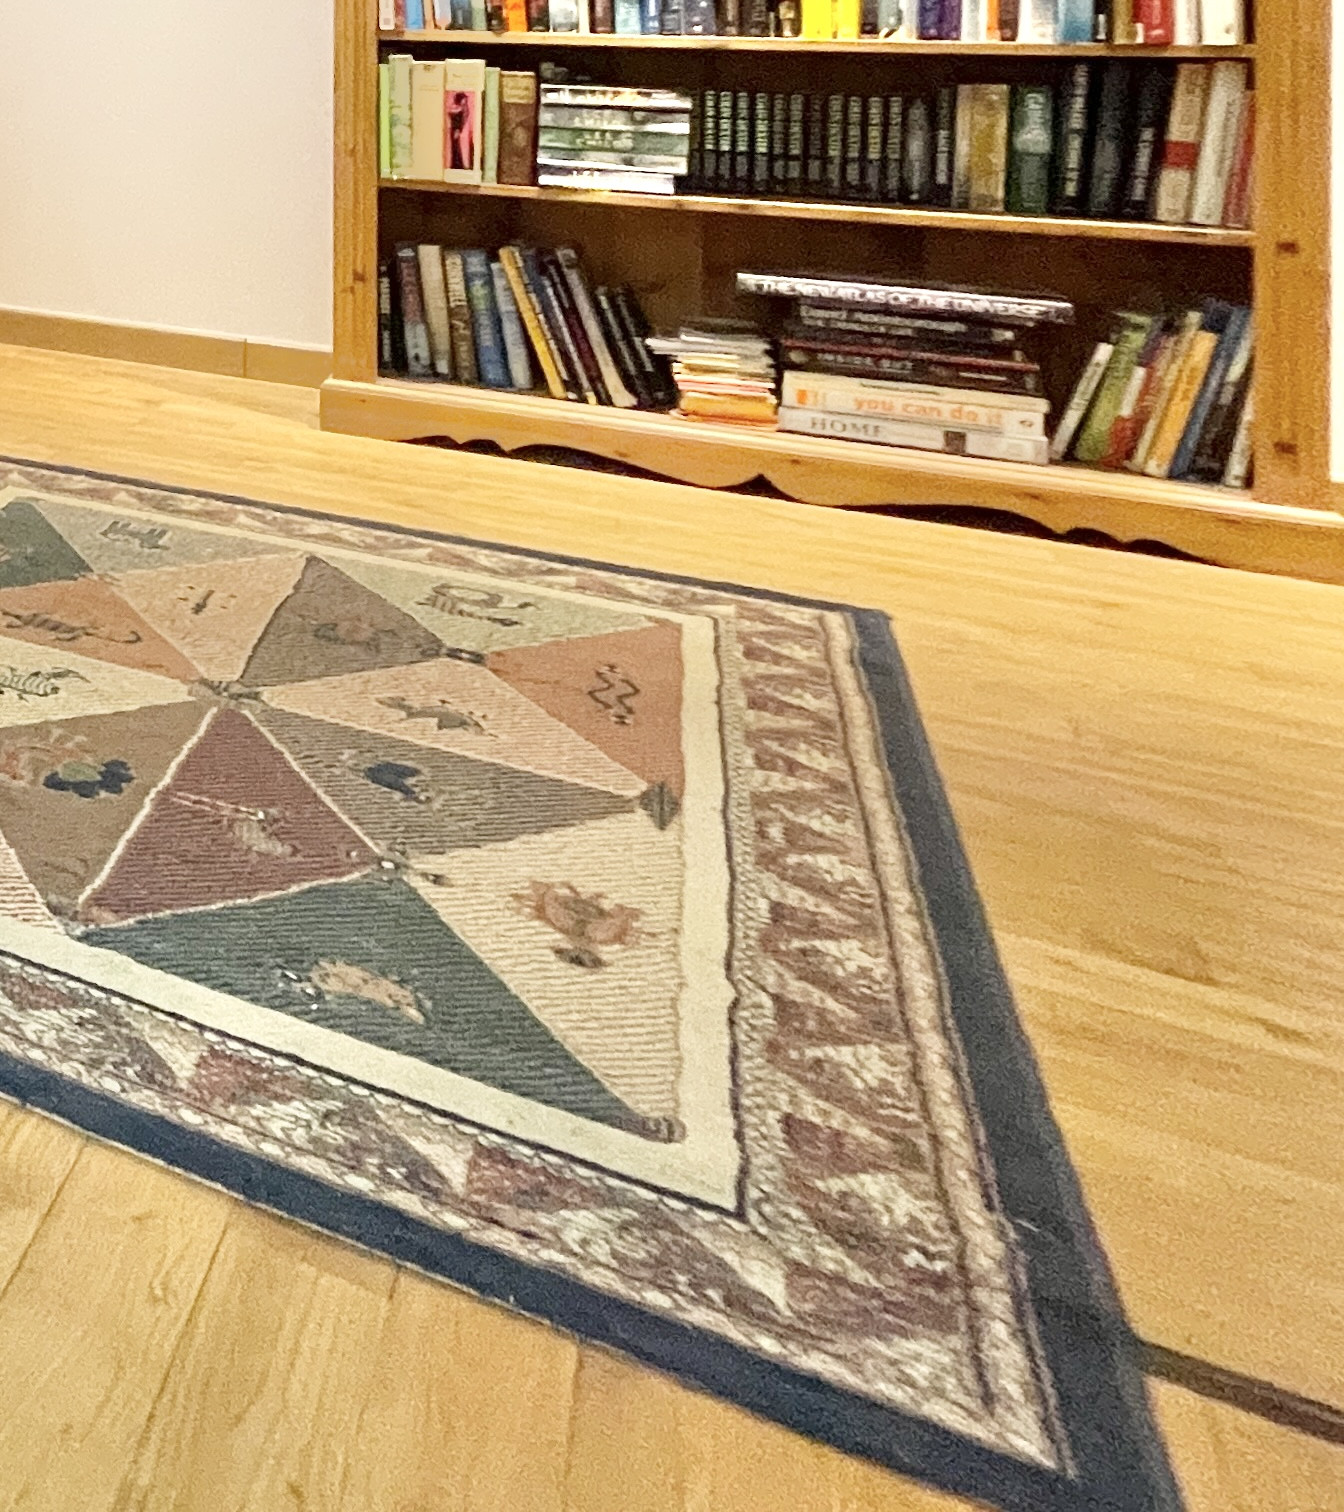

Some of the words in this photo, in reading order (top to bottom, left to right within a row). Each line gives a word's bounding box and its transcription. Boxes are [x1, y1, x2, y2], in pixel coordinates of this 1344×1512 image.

[761, 280, 795, 295] THE
[838, 286, 886, 302] ATLAS
[887, 291, 916, 305] OF
[917, 294, 953, 310] THE
[953, 297, 1046, 319] UNIVERSE
[854, 394, 895, 413] you
[901, 401, 942, 417] can
[950, 405, 979, 422] do
[986, 409, 1003, 425] it
[811, 417, 882, 438] HOME
